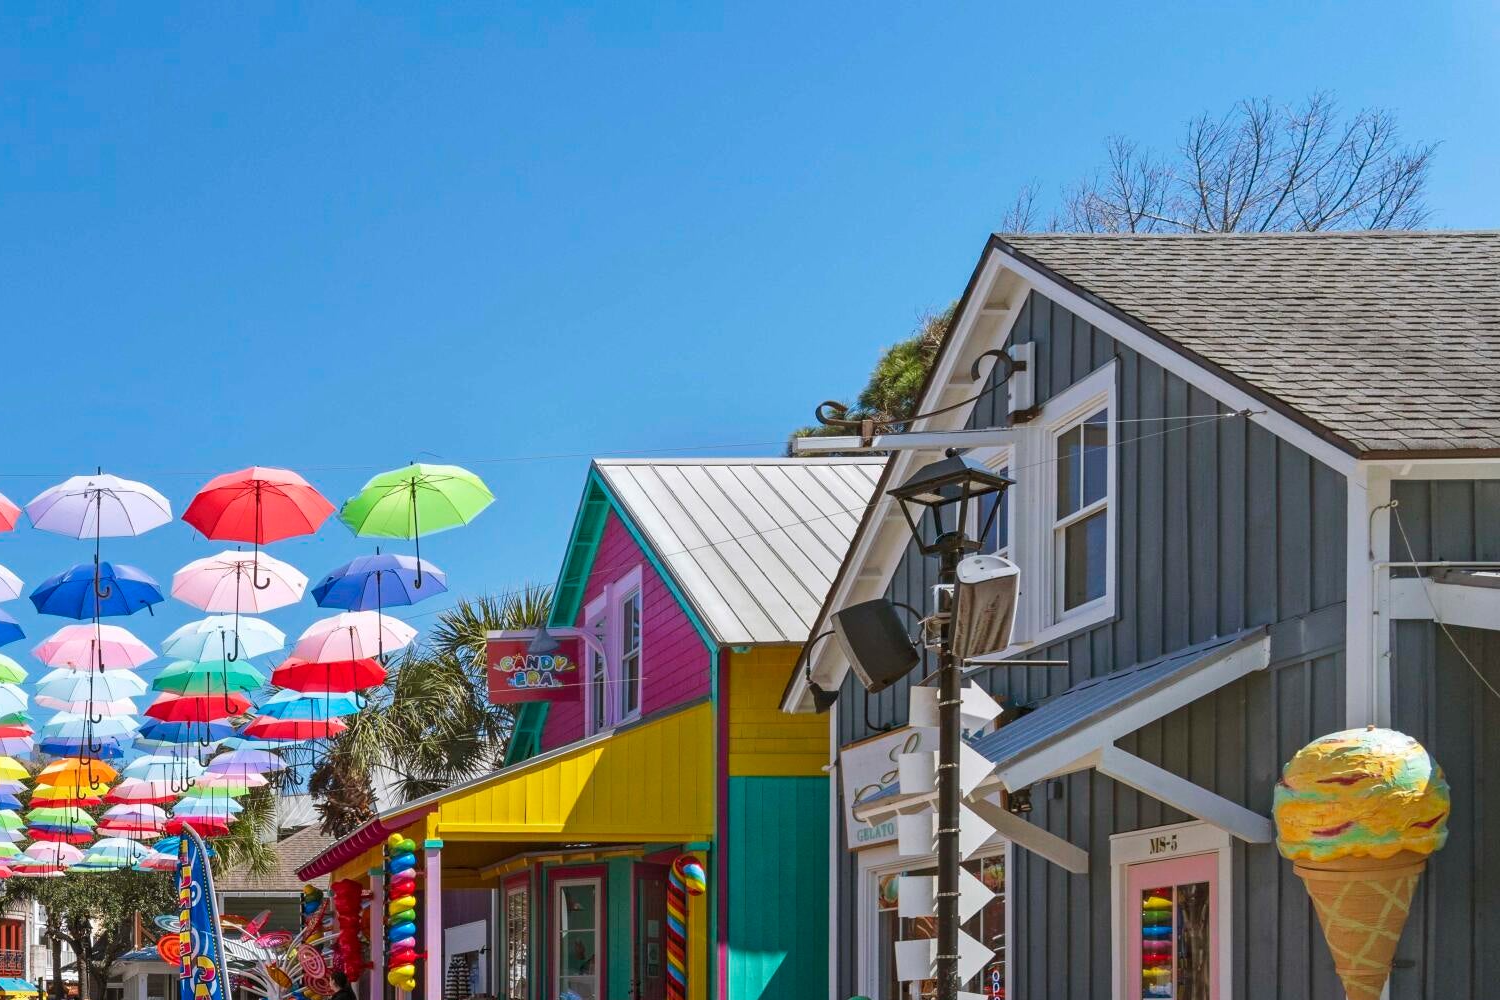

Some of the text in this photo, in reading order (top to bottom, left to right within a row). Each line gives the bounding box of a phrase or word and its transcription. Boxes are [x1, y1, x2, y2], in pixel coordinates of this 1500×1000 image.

[499, 655, 568, 672] CANDY
[514, 671, 554, 688] ERA
[857, 822, 894, 842] GELATO
[1150, 834, 1178, 855] MS-5
